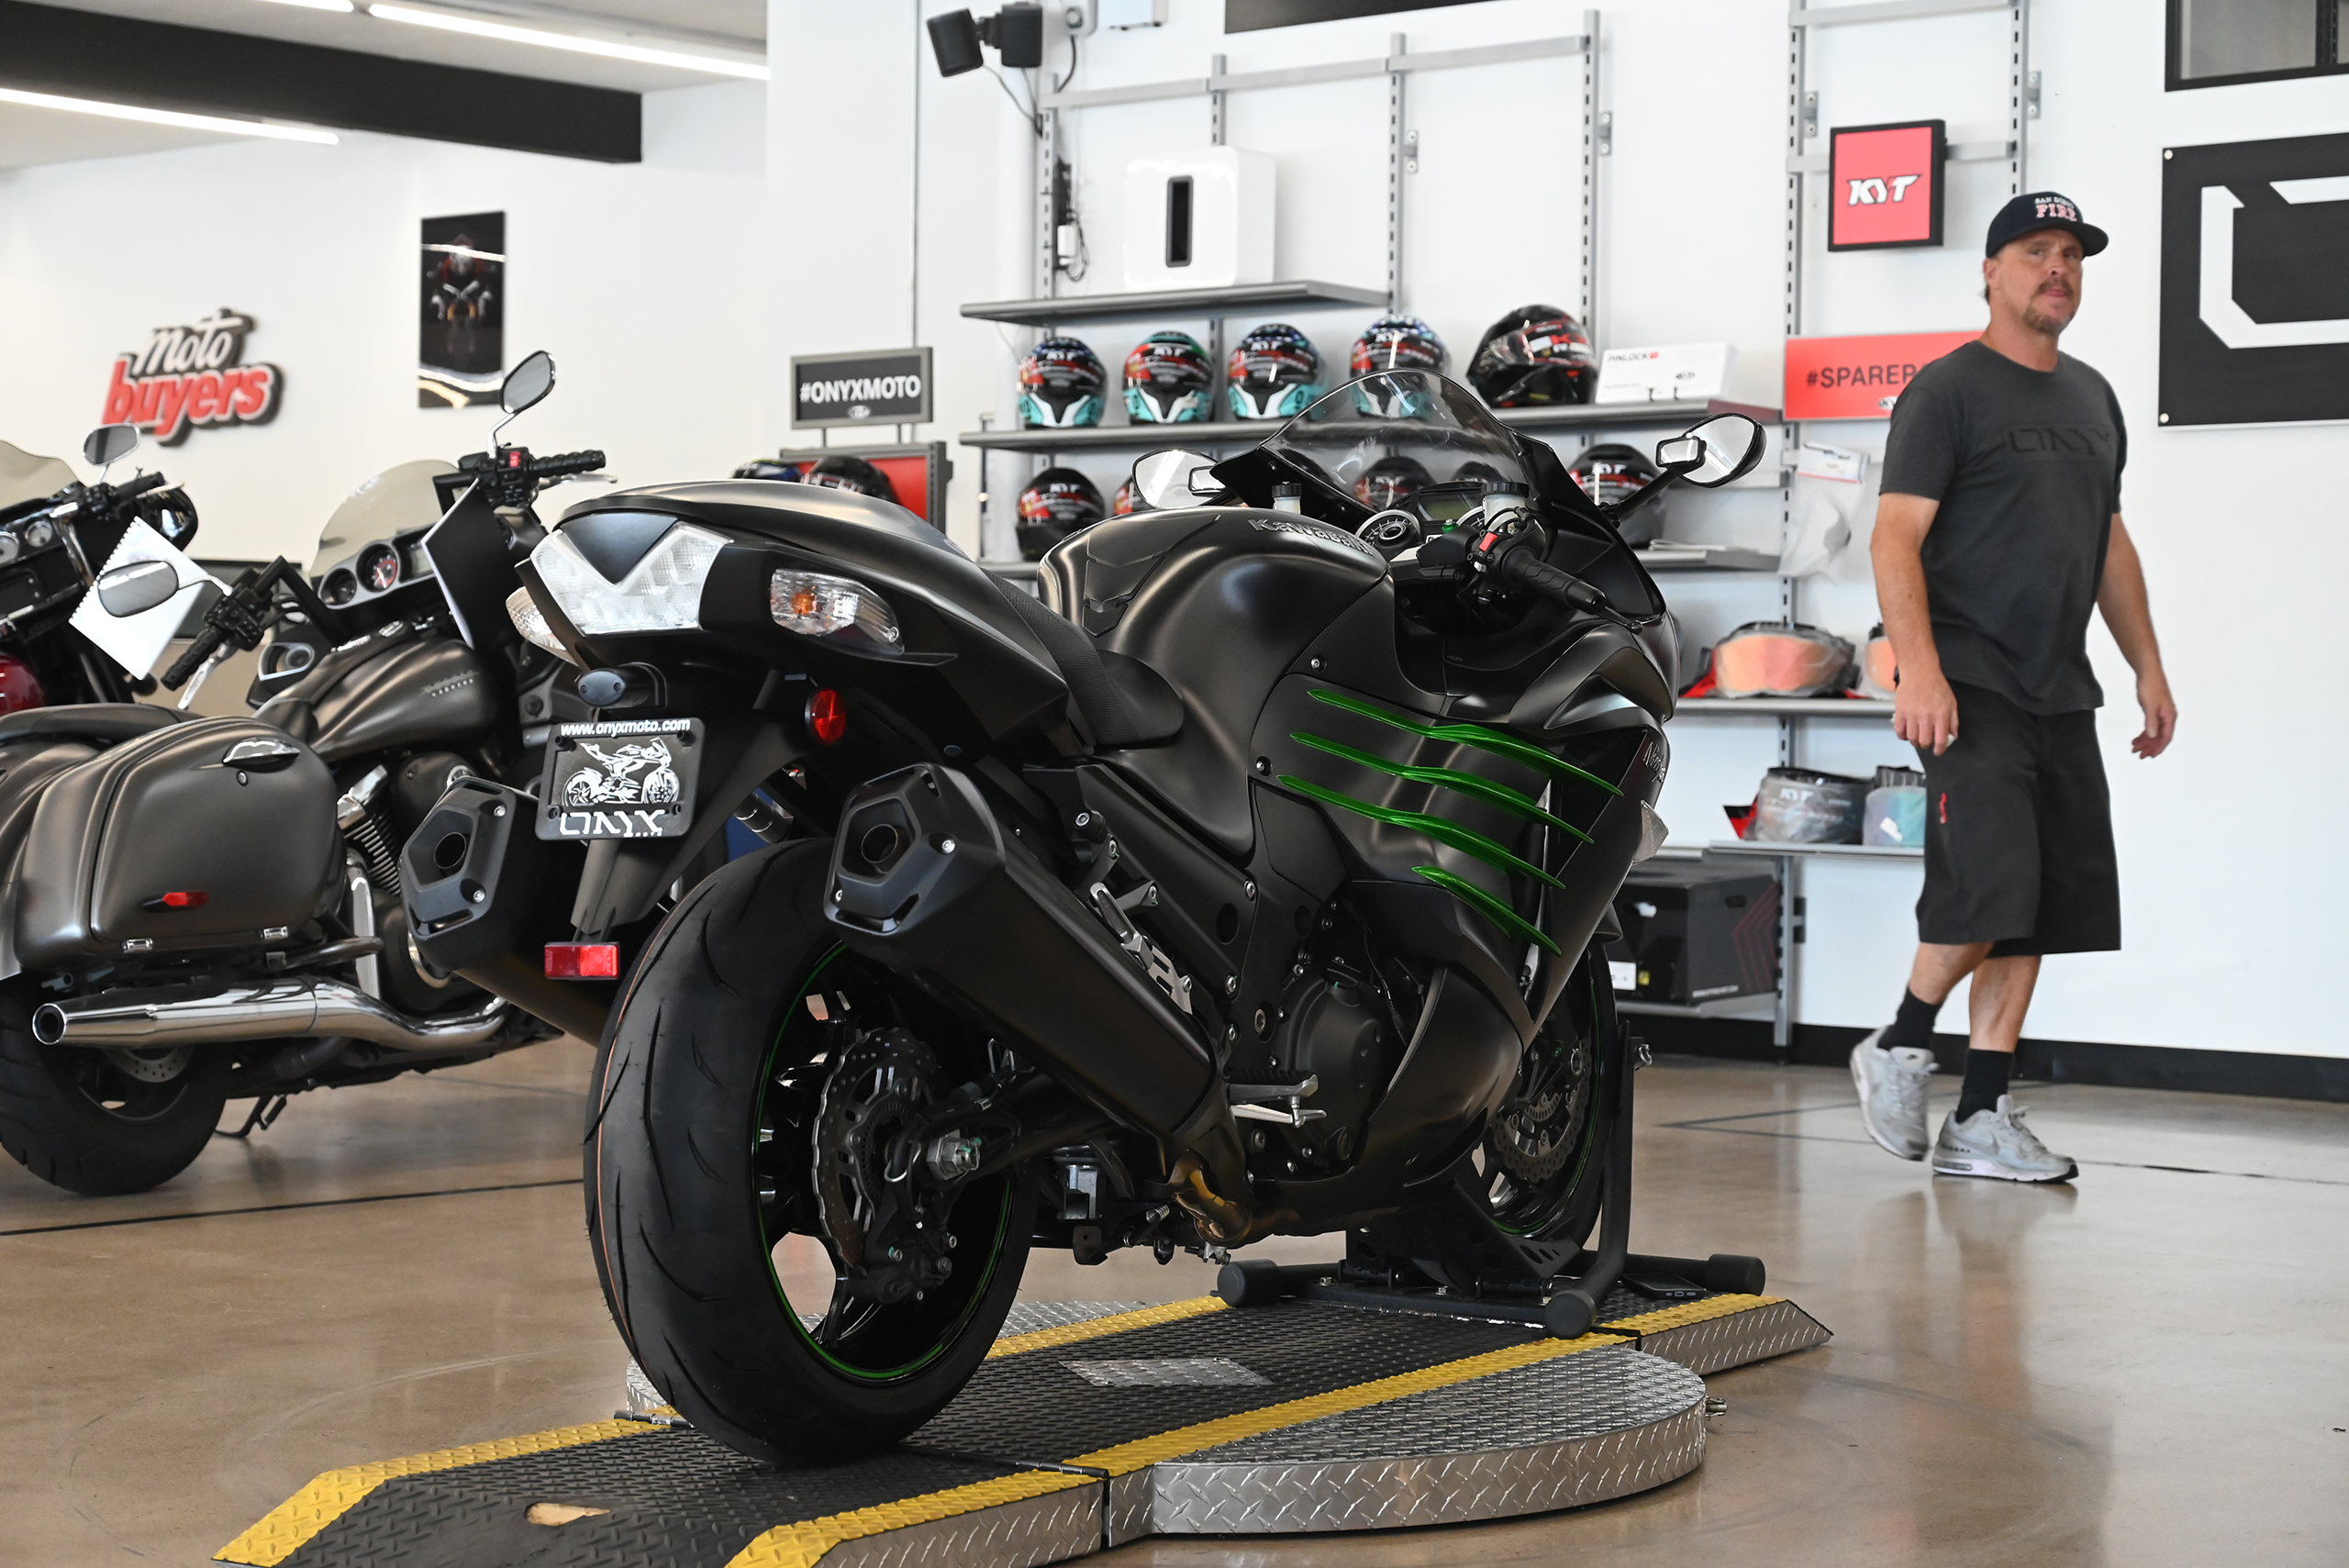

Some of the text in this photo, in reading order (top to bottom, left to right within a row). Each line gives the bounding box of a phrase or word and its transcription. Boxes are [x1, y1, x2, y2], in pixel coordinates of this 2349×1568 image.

[1847, 173, 1921, 206] KYT
[799, 374, 922, 405] #ONYXMOTO
[1807, 363, 1930, 389] #SPAREP
[101, 356, 273, 440] buyers
[1248, 517, 1375, 556] Kawasaki
[560, 718, 691, 738] www.onyxmoto.com
[559, 808, 666, 838] ONYX
